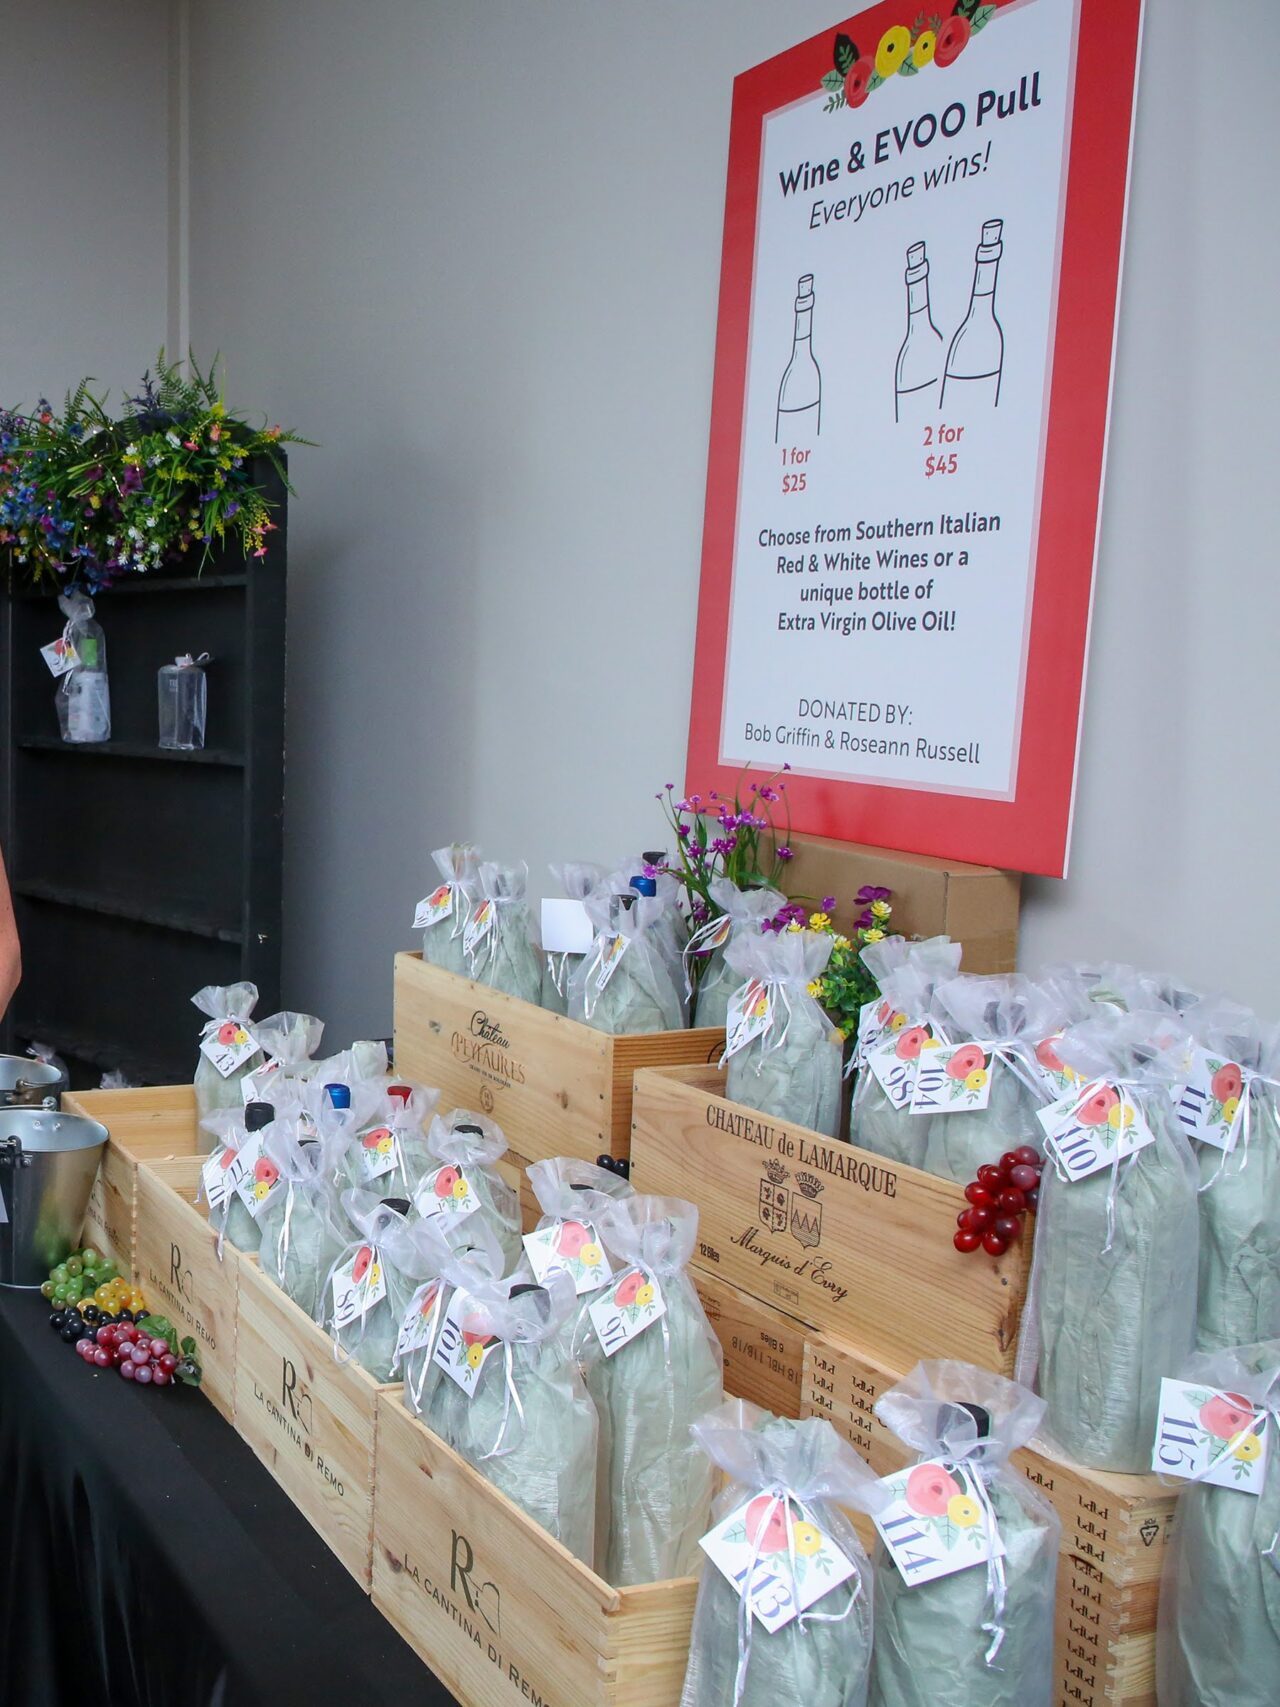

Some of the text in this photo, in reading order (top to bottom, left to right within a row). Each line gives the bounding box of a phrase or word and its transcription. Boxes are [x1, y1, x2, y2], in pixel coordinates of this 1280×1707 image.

[779, 71, 1041, 197] Wine & EVOO Pull
[809, 140, 992, 230] Everyone wins!
[923, 424, 964, 446] 2 for
[782, 447, 811, 466] 1 for
[925, 454, 958, 478] $45
[782, 473, 807, 494] $25
[758, 513, 1001, 548] Choose from Southern Italian
[776, 550, 969, 575] Red & White Wines or a
[800, 579, 933, 605] unique bottle of
[778, 611, 956, 636] Extra Virgin Olive Oil!
[799, 699, 913, 726] DONATED BY:
[745, 723, 981, 764] Bob Griffin & Roseann Russell
[882, 1066, 914, 1101] 98
[914, 1068, 945, 1109] 104
[706, 1104, 897, 1199] CHATEAU de LAMARQUE
[1053, 1123, 1097, 1171] 110
[730, 1226, 791, 1270] Marquis
[149, 1268, 217, 1350] LA CANTINA DI REMO
[437, 1317, 460, 1365] 101
[254, 1382, 345, 1497] LA CANTINA DI REMO
[1159, 1413, 1199, 1471] 115
[880, 1510, 942, 1574] 114
[731, 1558, 792, 1618] 113
[405, 1554, 420, 1582] LA
[424, 1578, 482, 1649] CANTINA
[488, 1644, 502, 1669] DI
